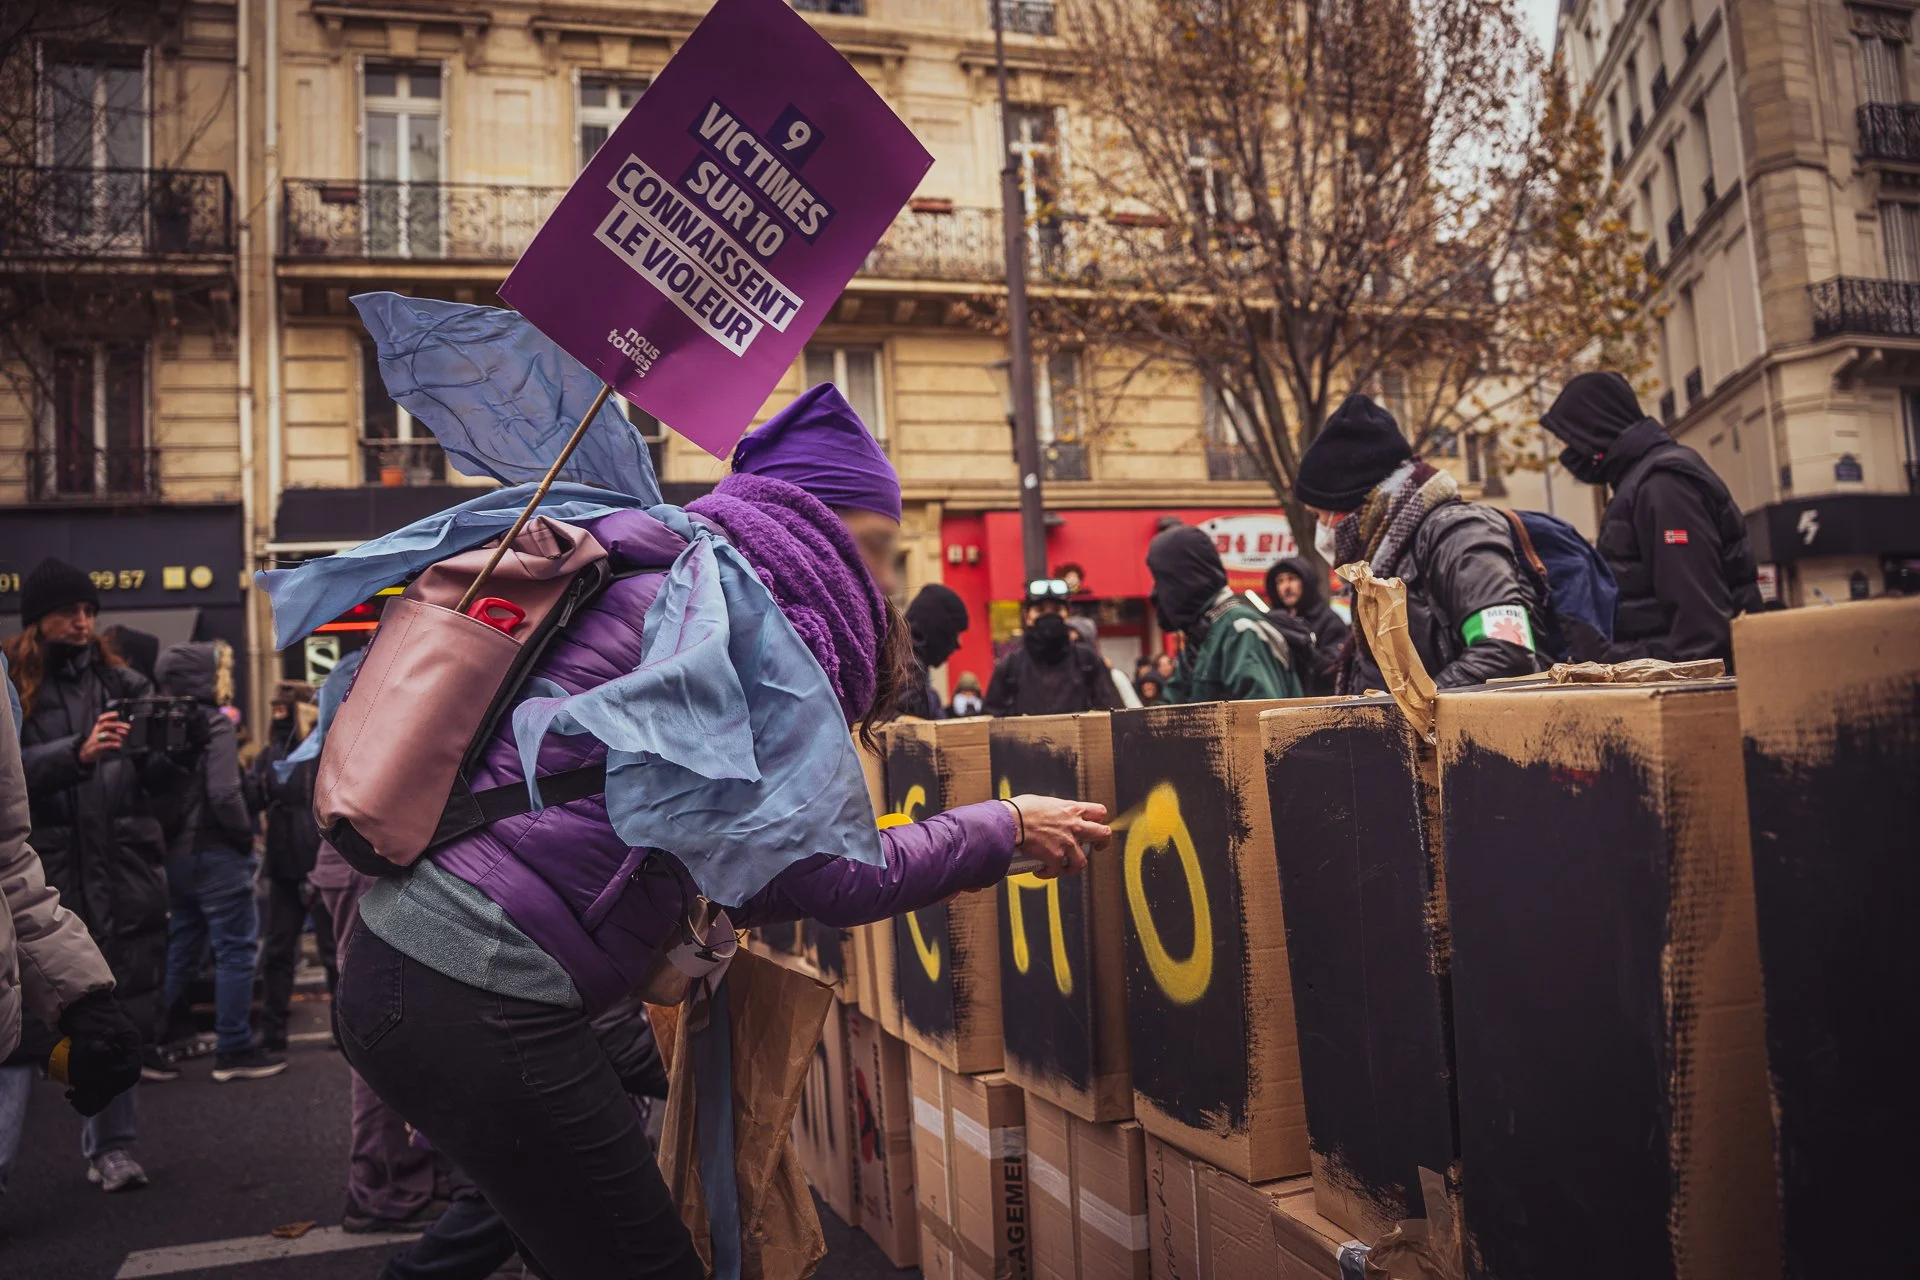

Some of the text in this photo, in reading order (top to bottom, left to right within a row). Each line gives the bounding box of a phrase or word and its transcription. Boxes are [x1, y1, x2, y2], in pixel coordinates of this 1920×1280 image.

[699, 102, 829, 236] VICTIMES
[782, 120, 812, 151] 9
[616, 162, 799, 325] CONNAISSENT
[686, 161, 785, 258] SUR 10
[604, 209, 753, 347] LE VIOLEUR
[607, 328, 652, 371] toutes
[625, 327, 661, 360] nous
